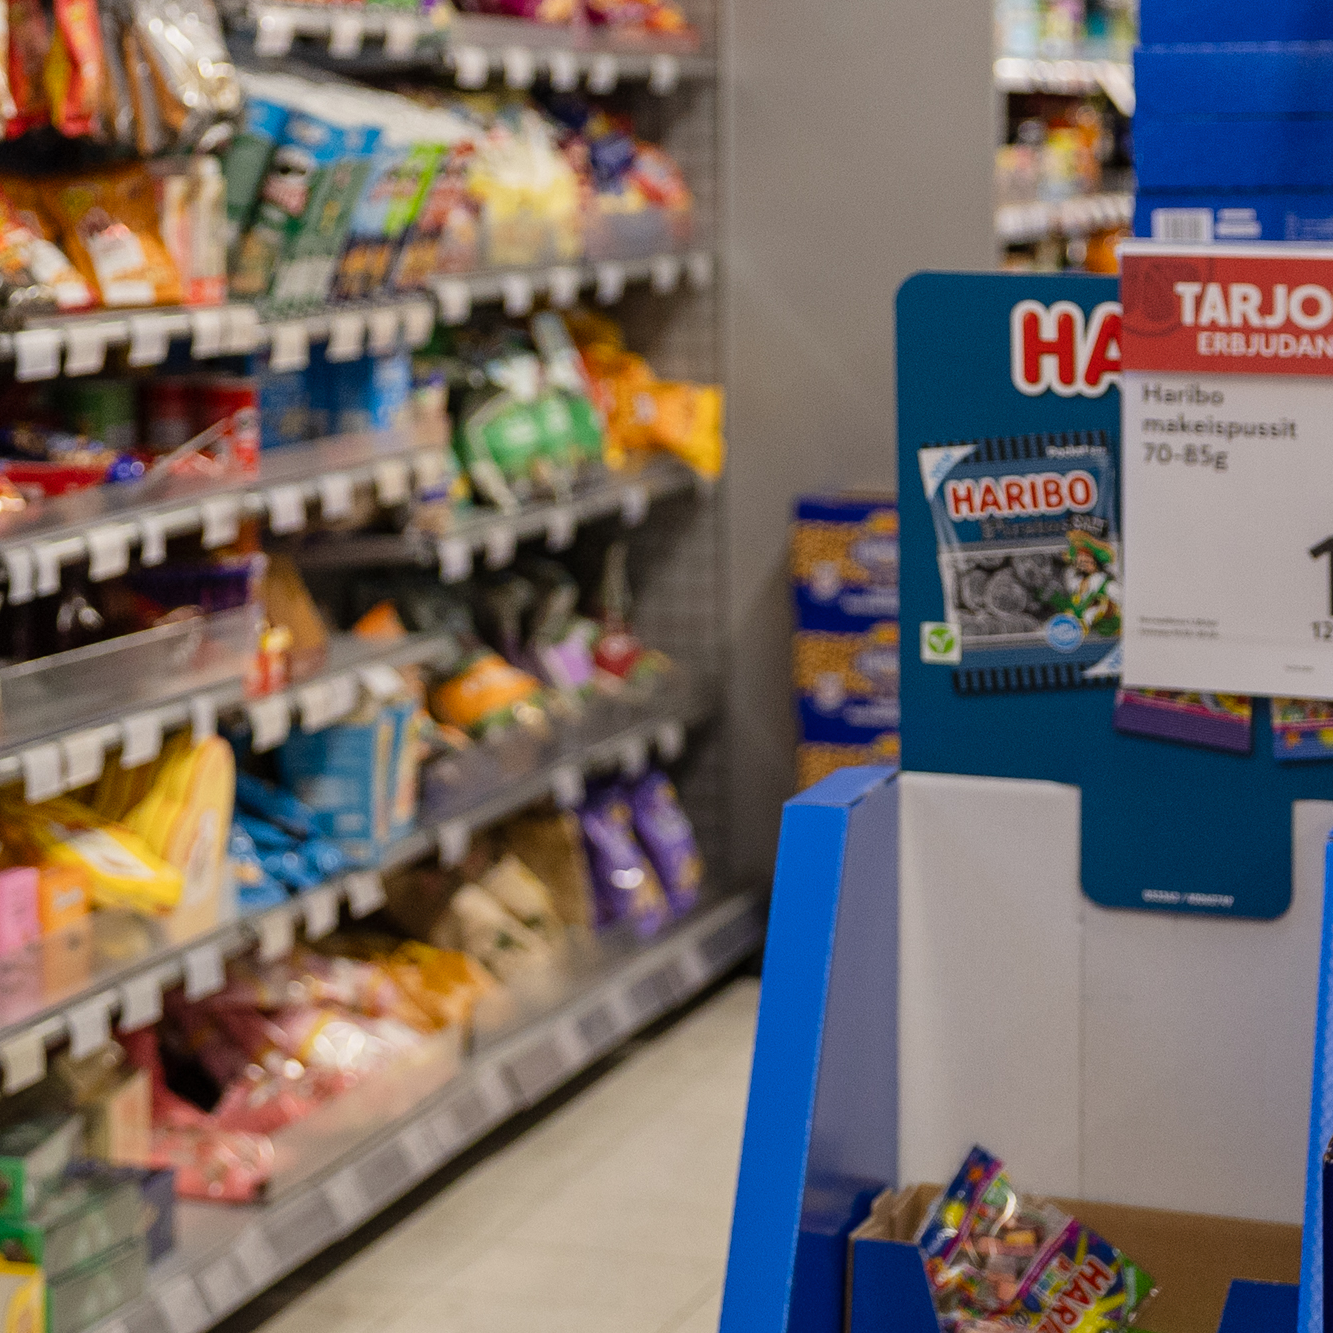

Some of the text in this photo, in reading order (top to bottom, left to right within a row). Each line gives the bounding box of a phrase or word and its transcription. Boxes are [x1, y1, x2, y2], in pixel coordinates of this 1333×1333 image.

[1173, 281, 1333, 330] TARJO
[1142, 382, 1225, 406] Haribo
[1142, 412, 1297, 442] makeispussit
[1144, 442, 1228, 472] 70-85g
[946, 472, 1097, 521] HARIBO
